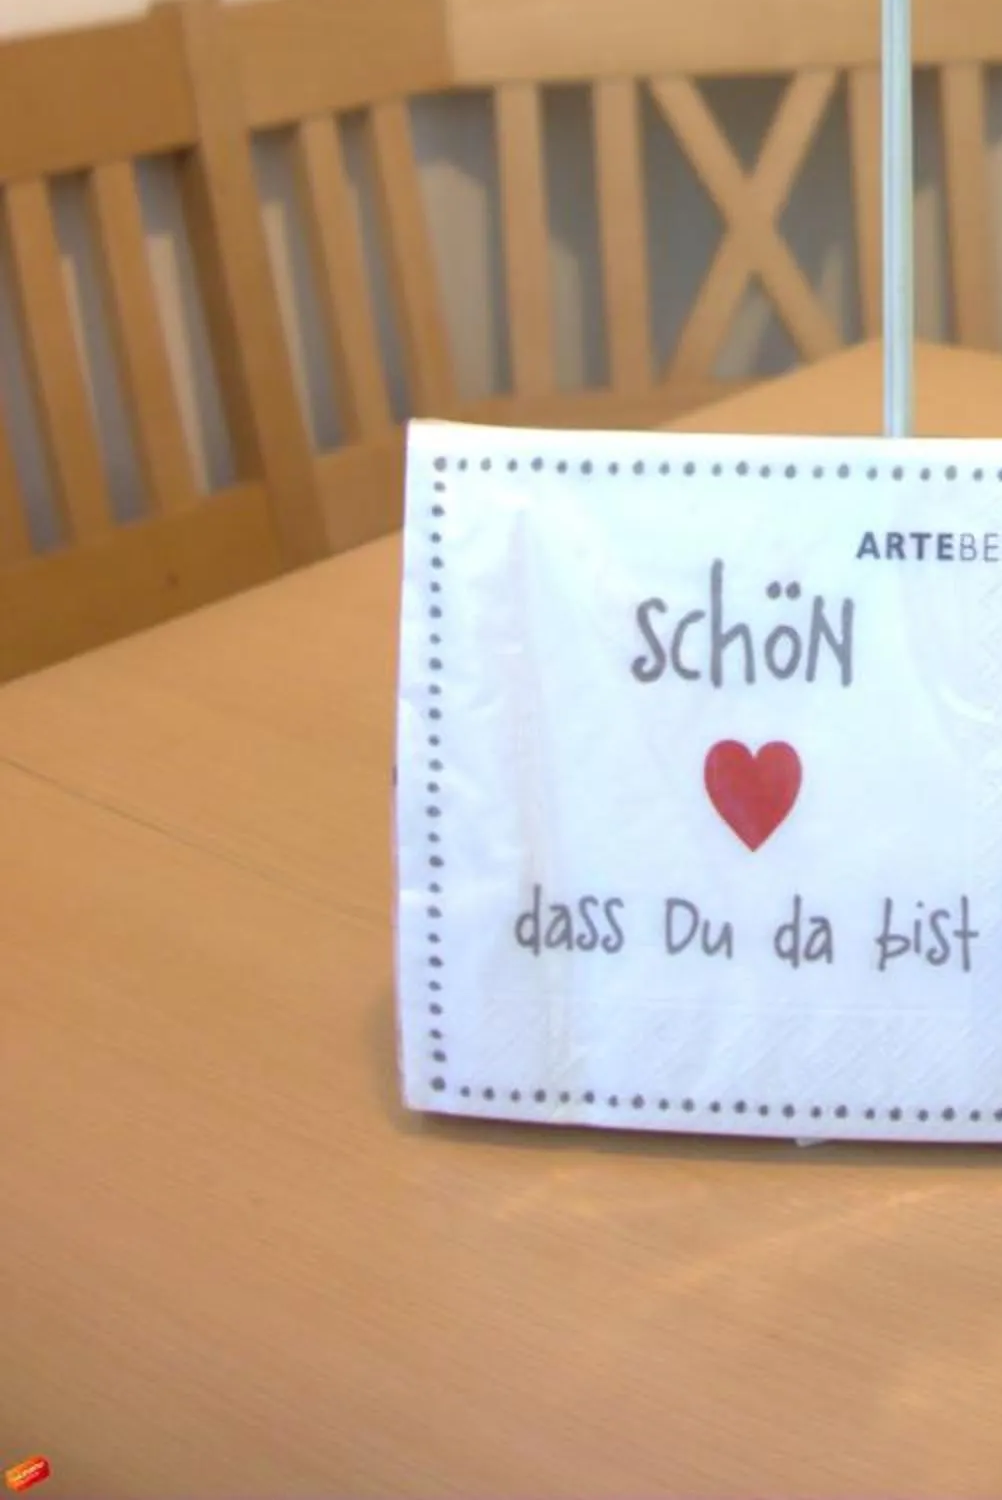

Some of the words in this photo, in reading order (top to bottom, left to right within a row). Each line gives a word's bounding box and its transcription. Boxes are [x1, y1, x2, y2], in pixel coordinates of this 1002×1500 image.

[514, 883, 626, 957] dass
[664, 897, 734, 960] Du
[773, 894, 835, 970] da
[874, 895, 980, 973] bist
